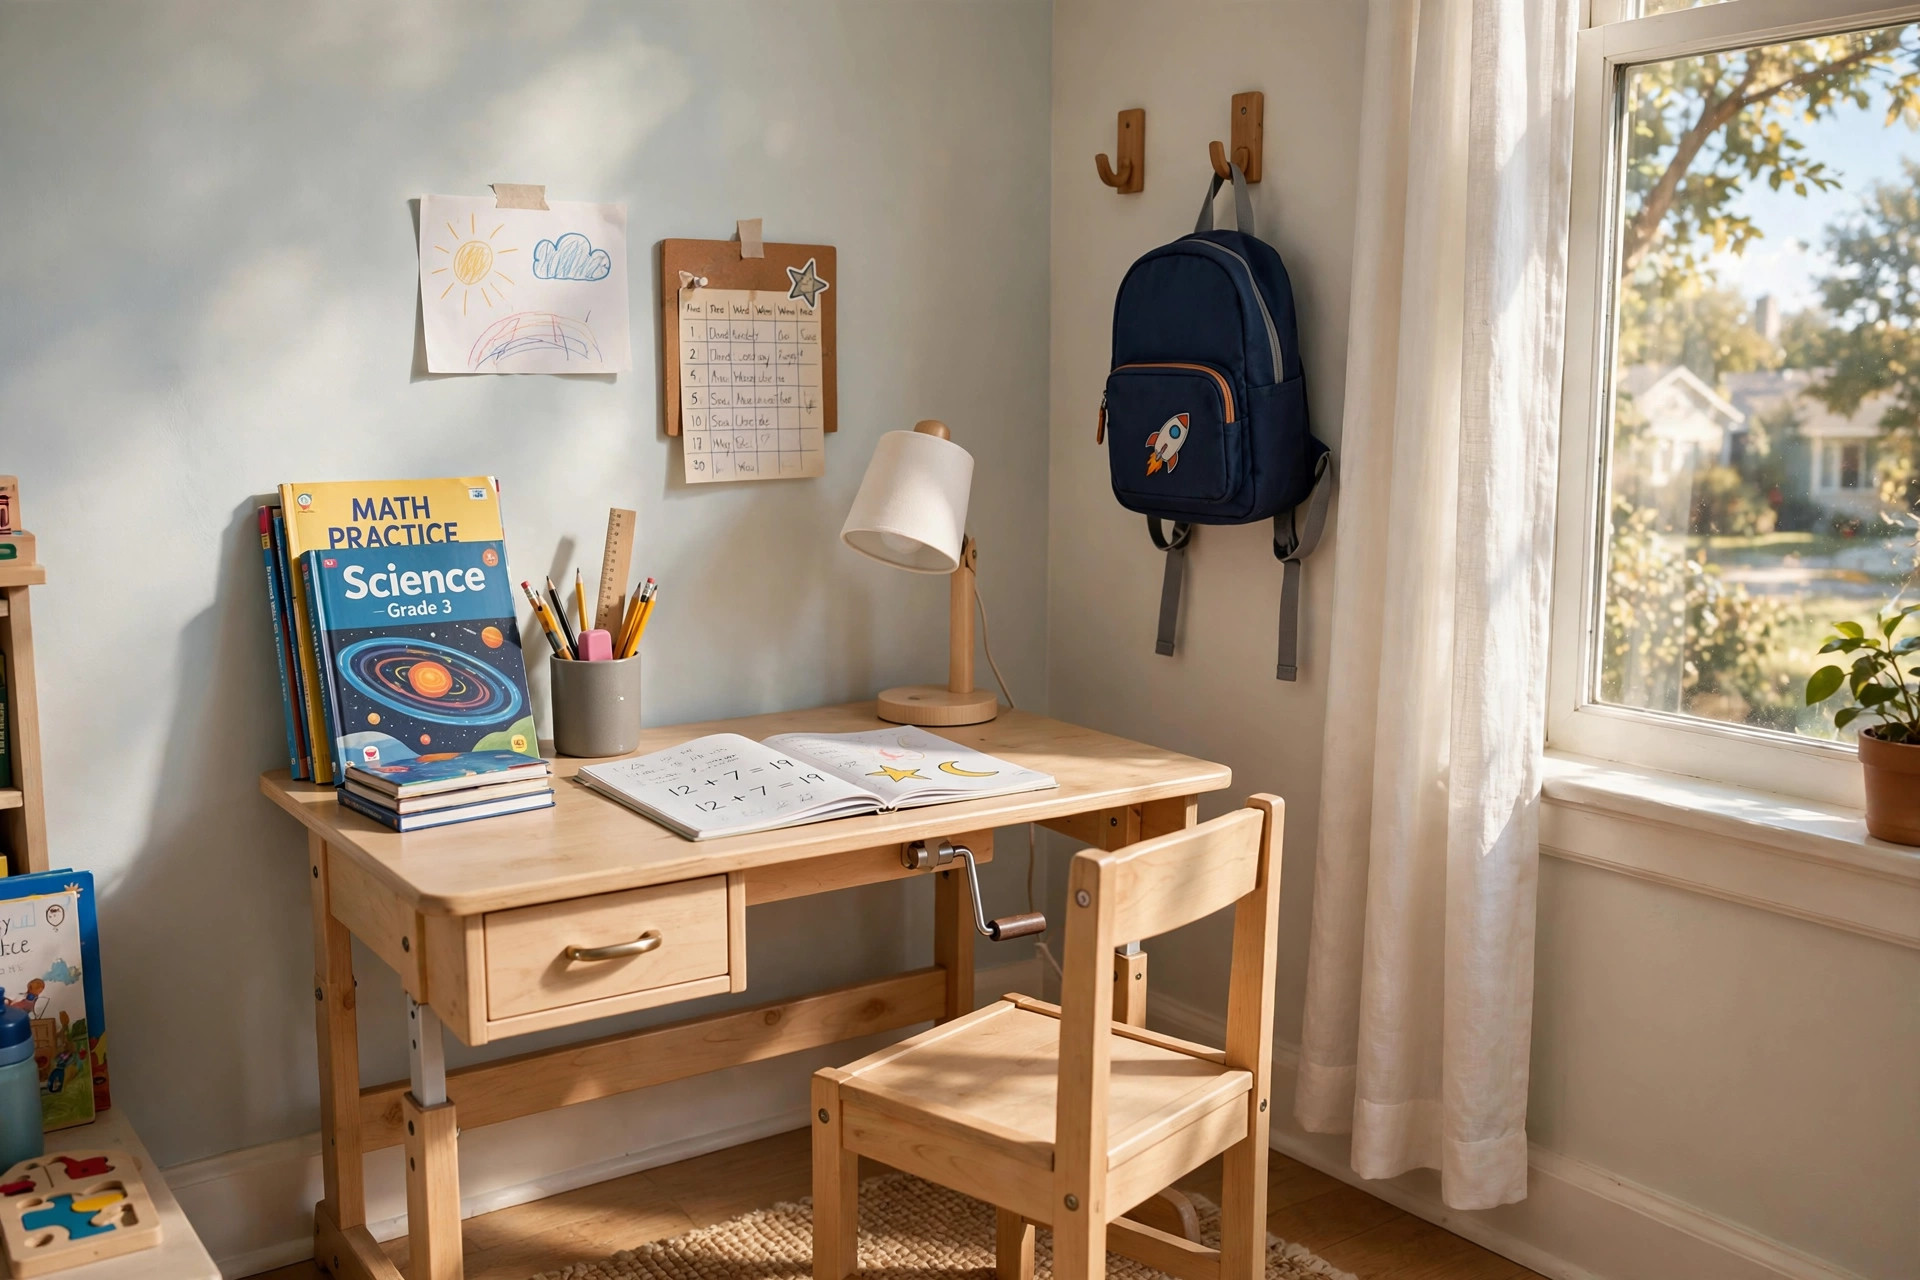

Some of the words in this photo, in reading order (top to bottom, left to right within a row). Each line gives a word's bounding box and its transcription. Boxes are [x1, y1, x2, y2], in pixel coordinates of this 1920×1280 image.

[689, 348, 696, 360] 2
[352, 496, 431, 521] MATH
[328, 522, 459, 549] PRACTICE
[343, 562, 486, 600] Science
[387, 600, 438, 618] Grade
[442, 599, 452, 614] 3
[668, 784, 698, 797] 12
[723, 770, 739, 781] 7
[749, 766, 764, 774] =
[769, 758, 794, 770] 19
[695, 799, 727, 812] 12
[749, 784, 767, 796] 7
[778, 781, 794, 789] =
[799, 773, 825, 785] 19
